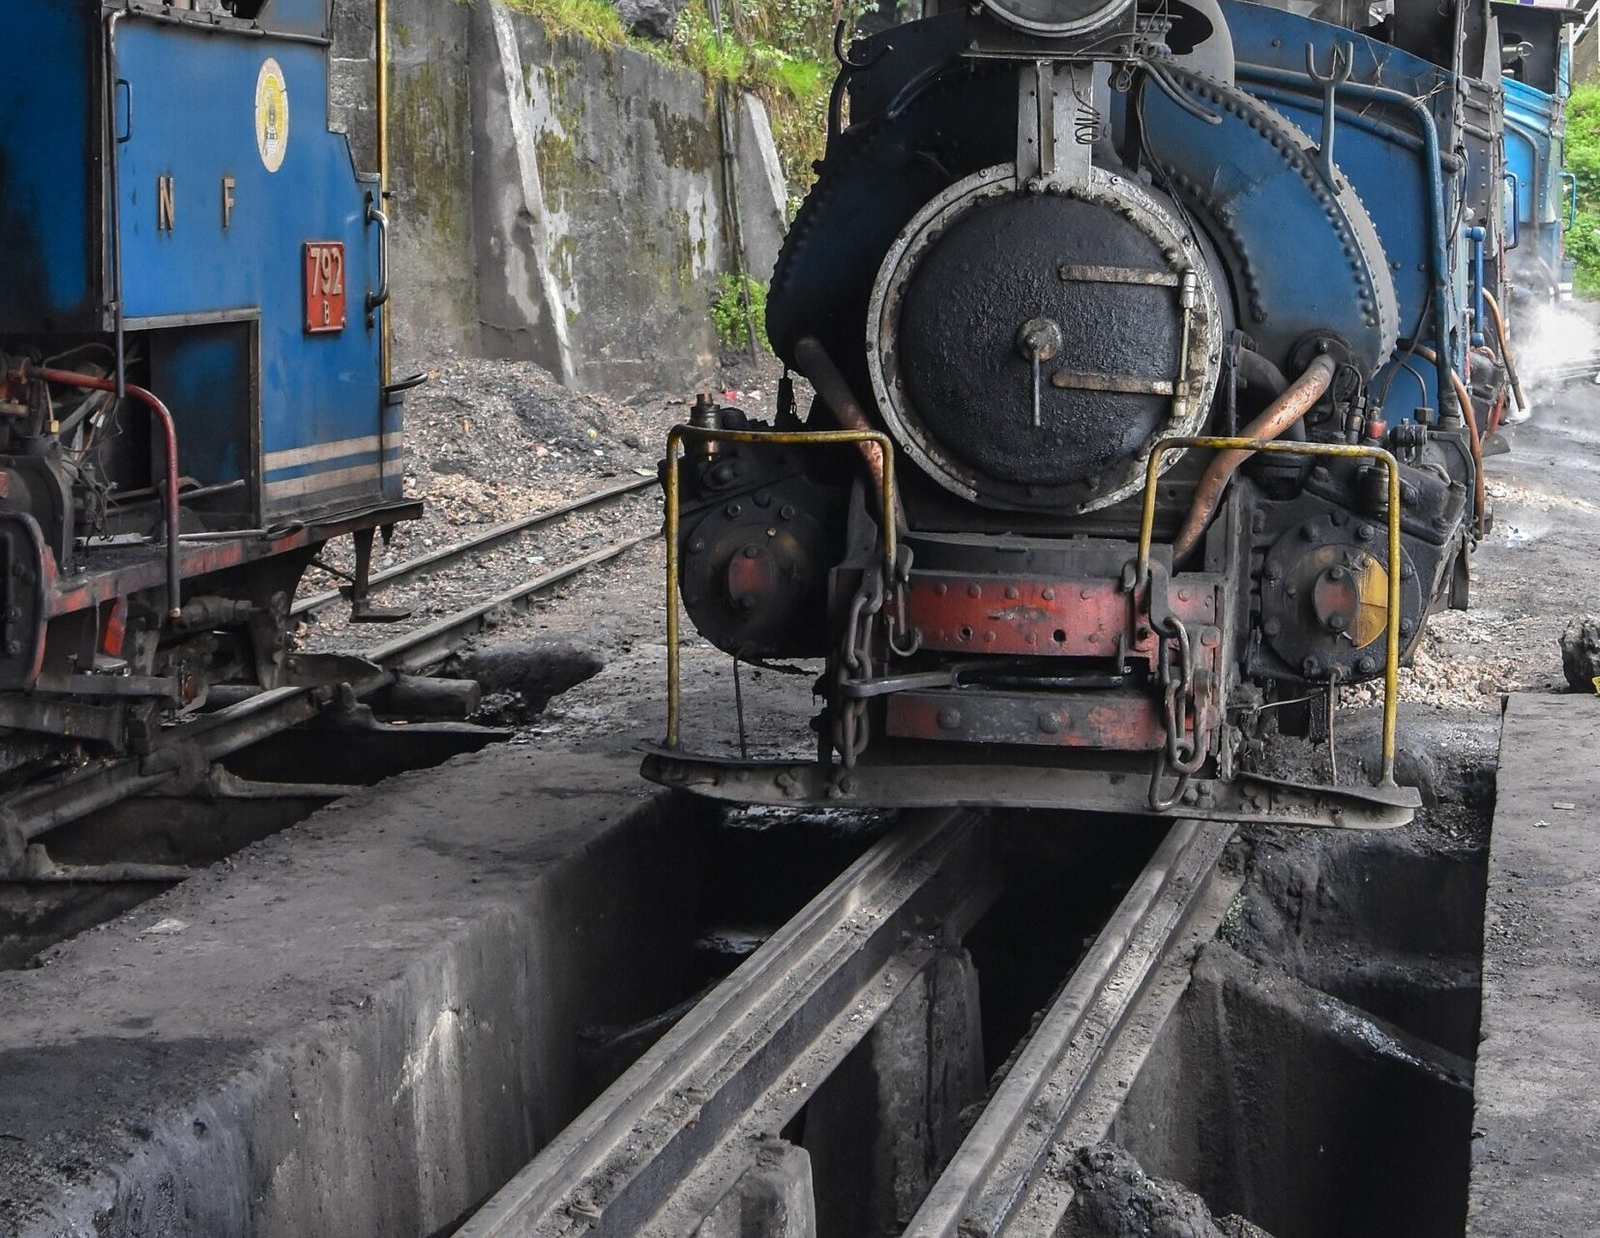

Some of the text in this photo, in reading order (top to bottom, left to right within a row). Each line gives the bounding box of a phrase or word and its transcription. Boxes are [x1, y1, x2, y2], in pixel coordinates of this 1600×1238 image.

[158, 177, 235, 230] N F
[310, 247, 343, 296] 792
[323, 299, 331, 325] B
